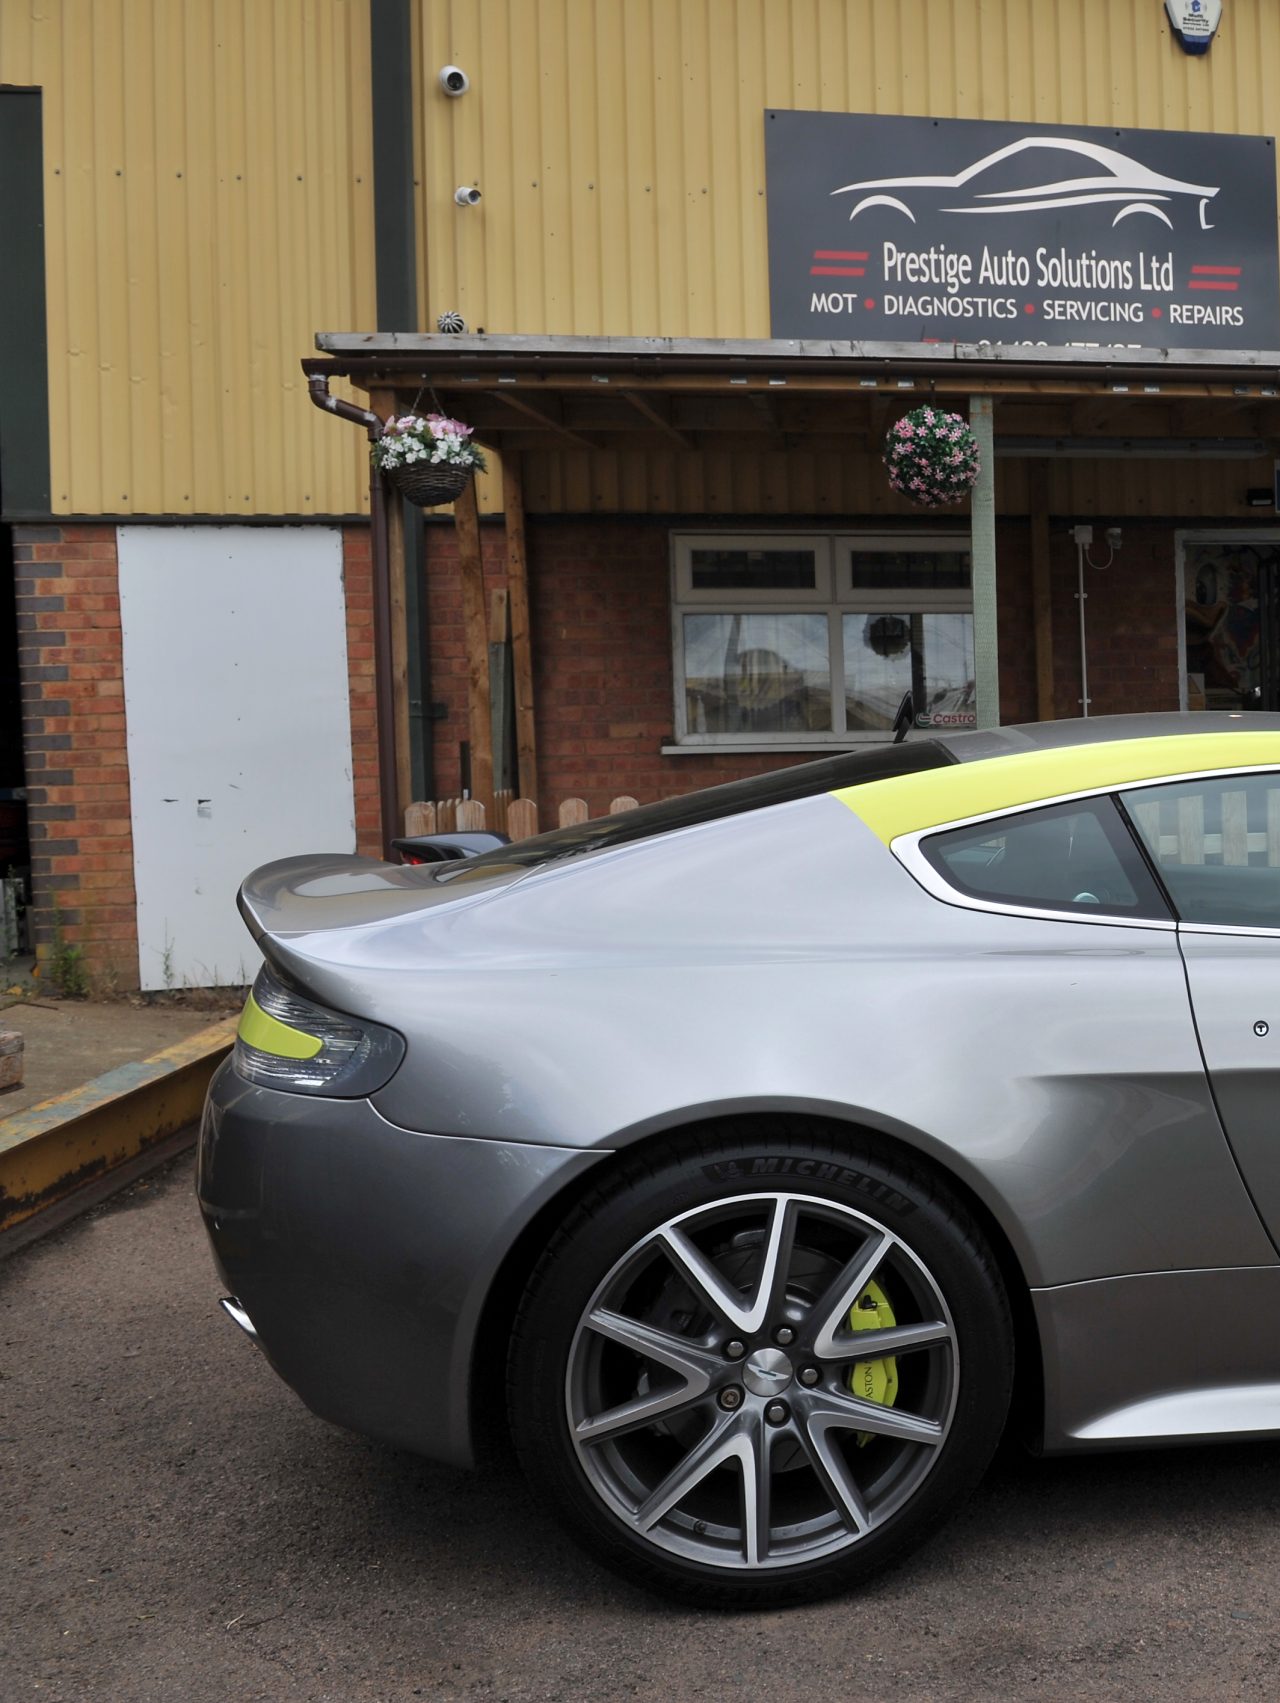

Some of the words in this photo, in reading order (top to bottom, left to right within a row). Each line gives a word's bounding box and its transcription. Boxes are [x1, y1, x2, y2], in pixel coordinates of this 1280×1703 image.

[883, 241, 972, 294] Prestige
[978, 245, 1030, 286] Auto
[1036, 246, 1133, 291] Solutions
[1139, 252, 1174, 291] Ltd
[810, 293, 858, 314] MOT
[884, 295, 1018, 318] DIAGNOSTICS
[1043, 300, 1143, 323] SERVICING
[1169, 304, 1244, 326] REPAIRS
[933, 714, 976, 723] Castro
[751, 1158, 909, 1211] MICHELIN
[864, 1366, 873, 1398] ASTON
